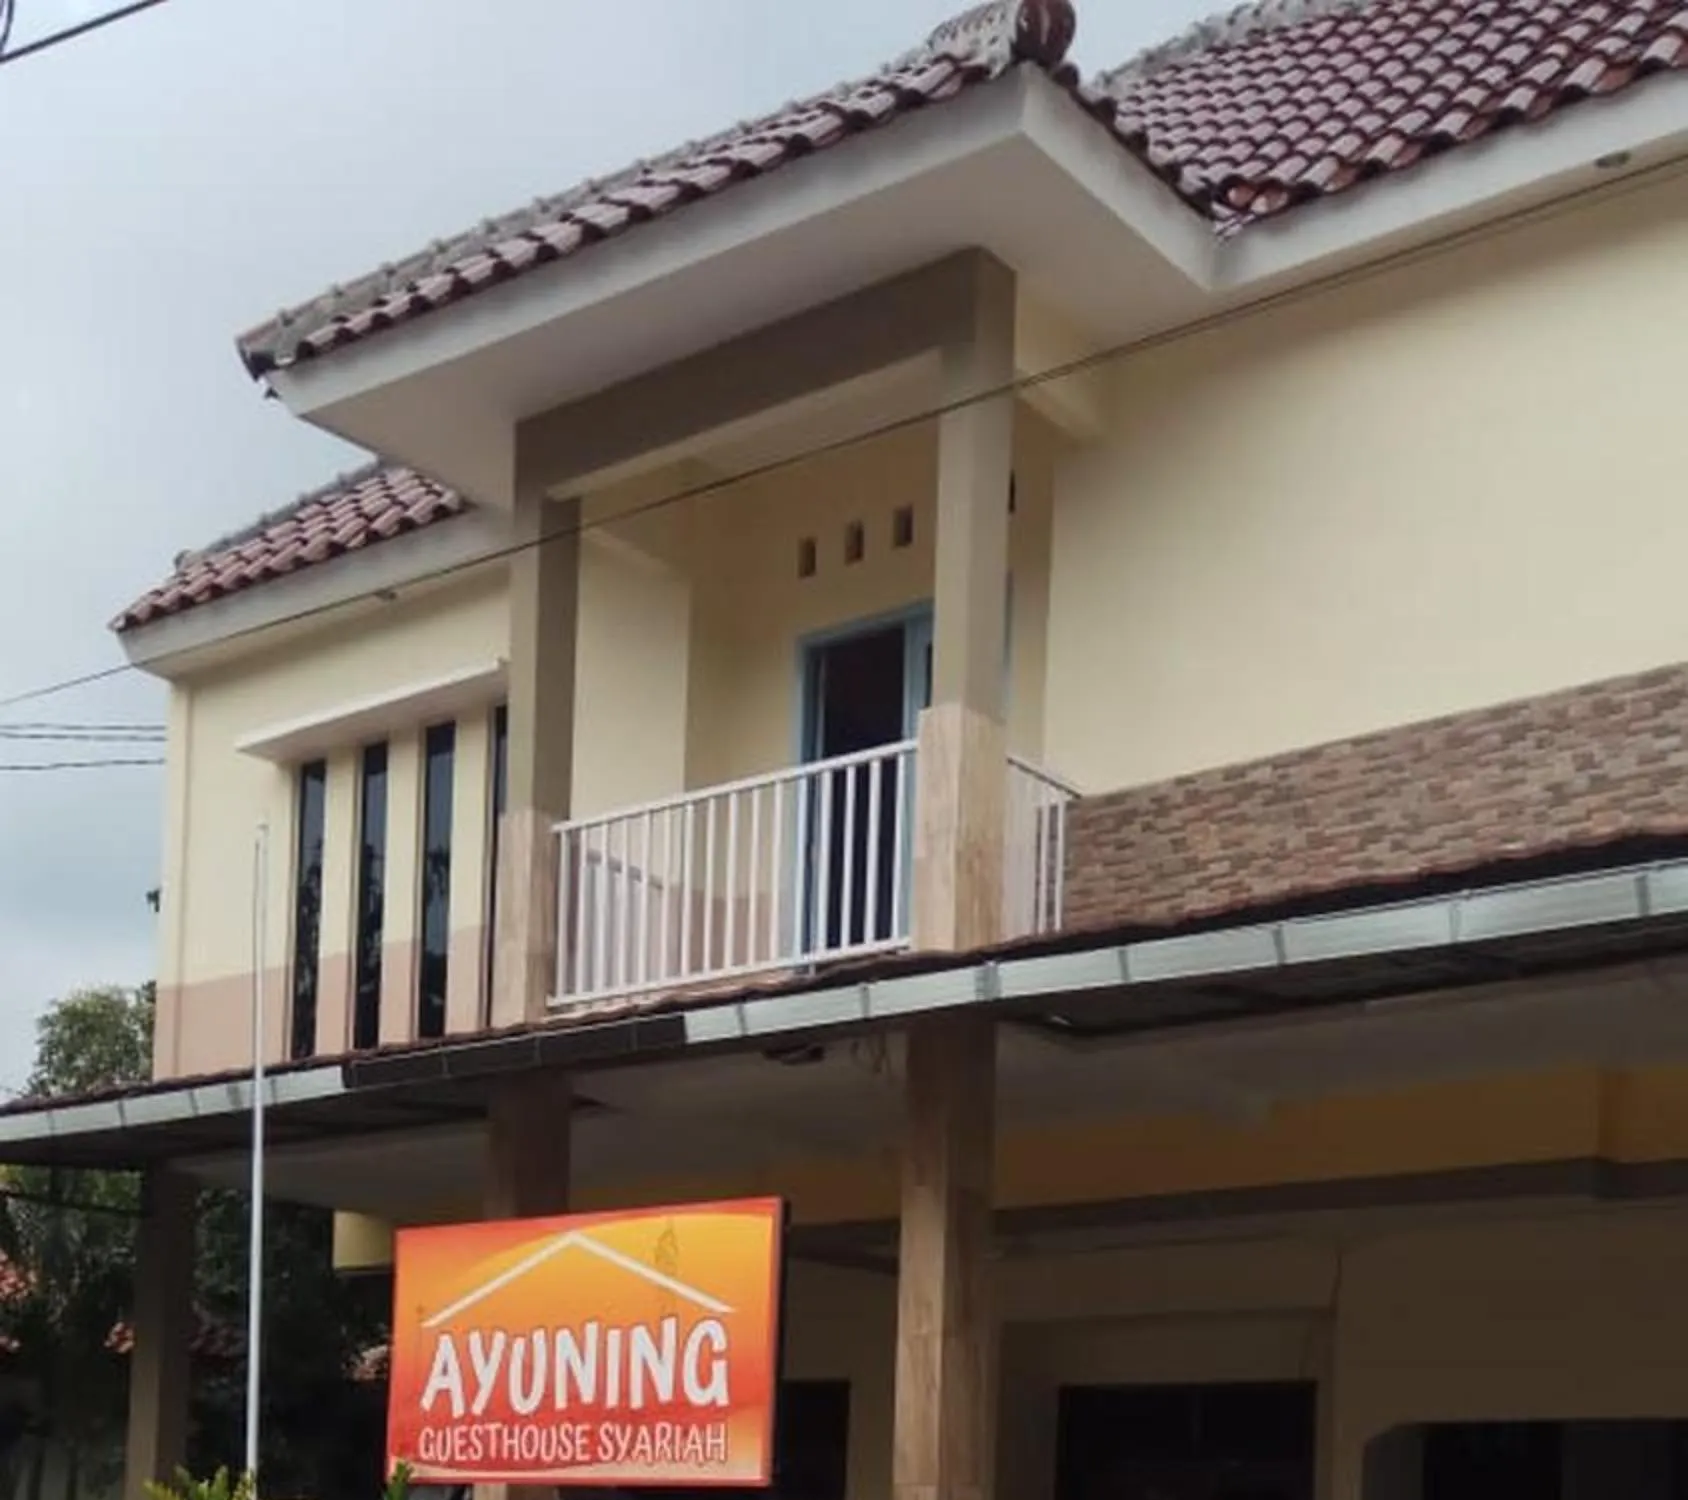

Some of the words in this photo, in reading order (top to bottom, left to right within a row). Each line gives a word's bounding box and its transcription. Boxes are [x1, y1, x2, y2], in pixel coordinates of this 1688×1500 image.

[420, 1316, 729, 1418] AYUNING
[418, 1422, 591, 1462] GUESTHOUSE
[599, 1421, 727, 1463] SYARIAH
